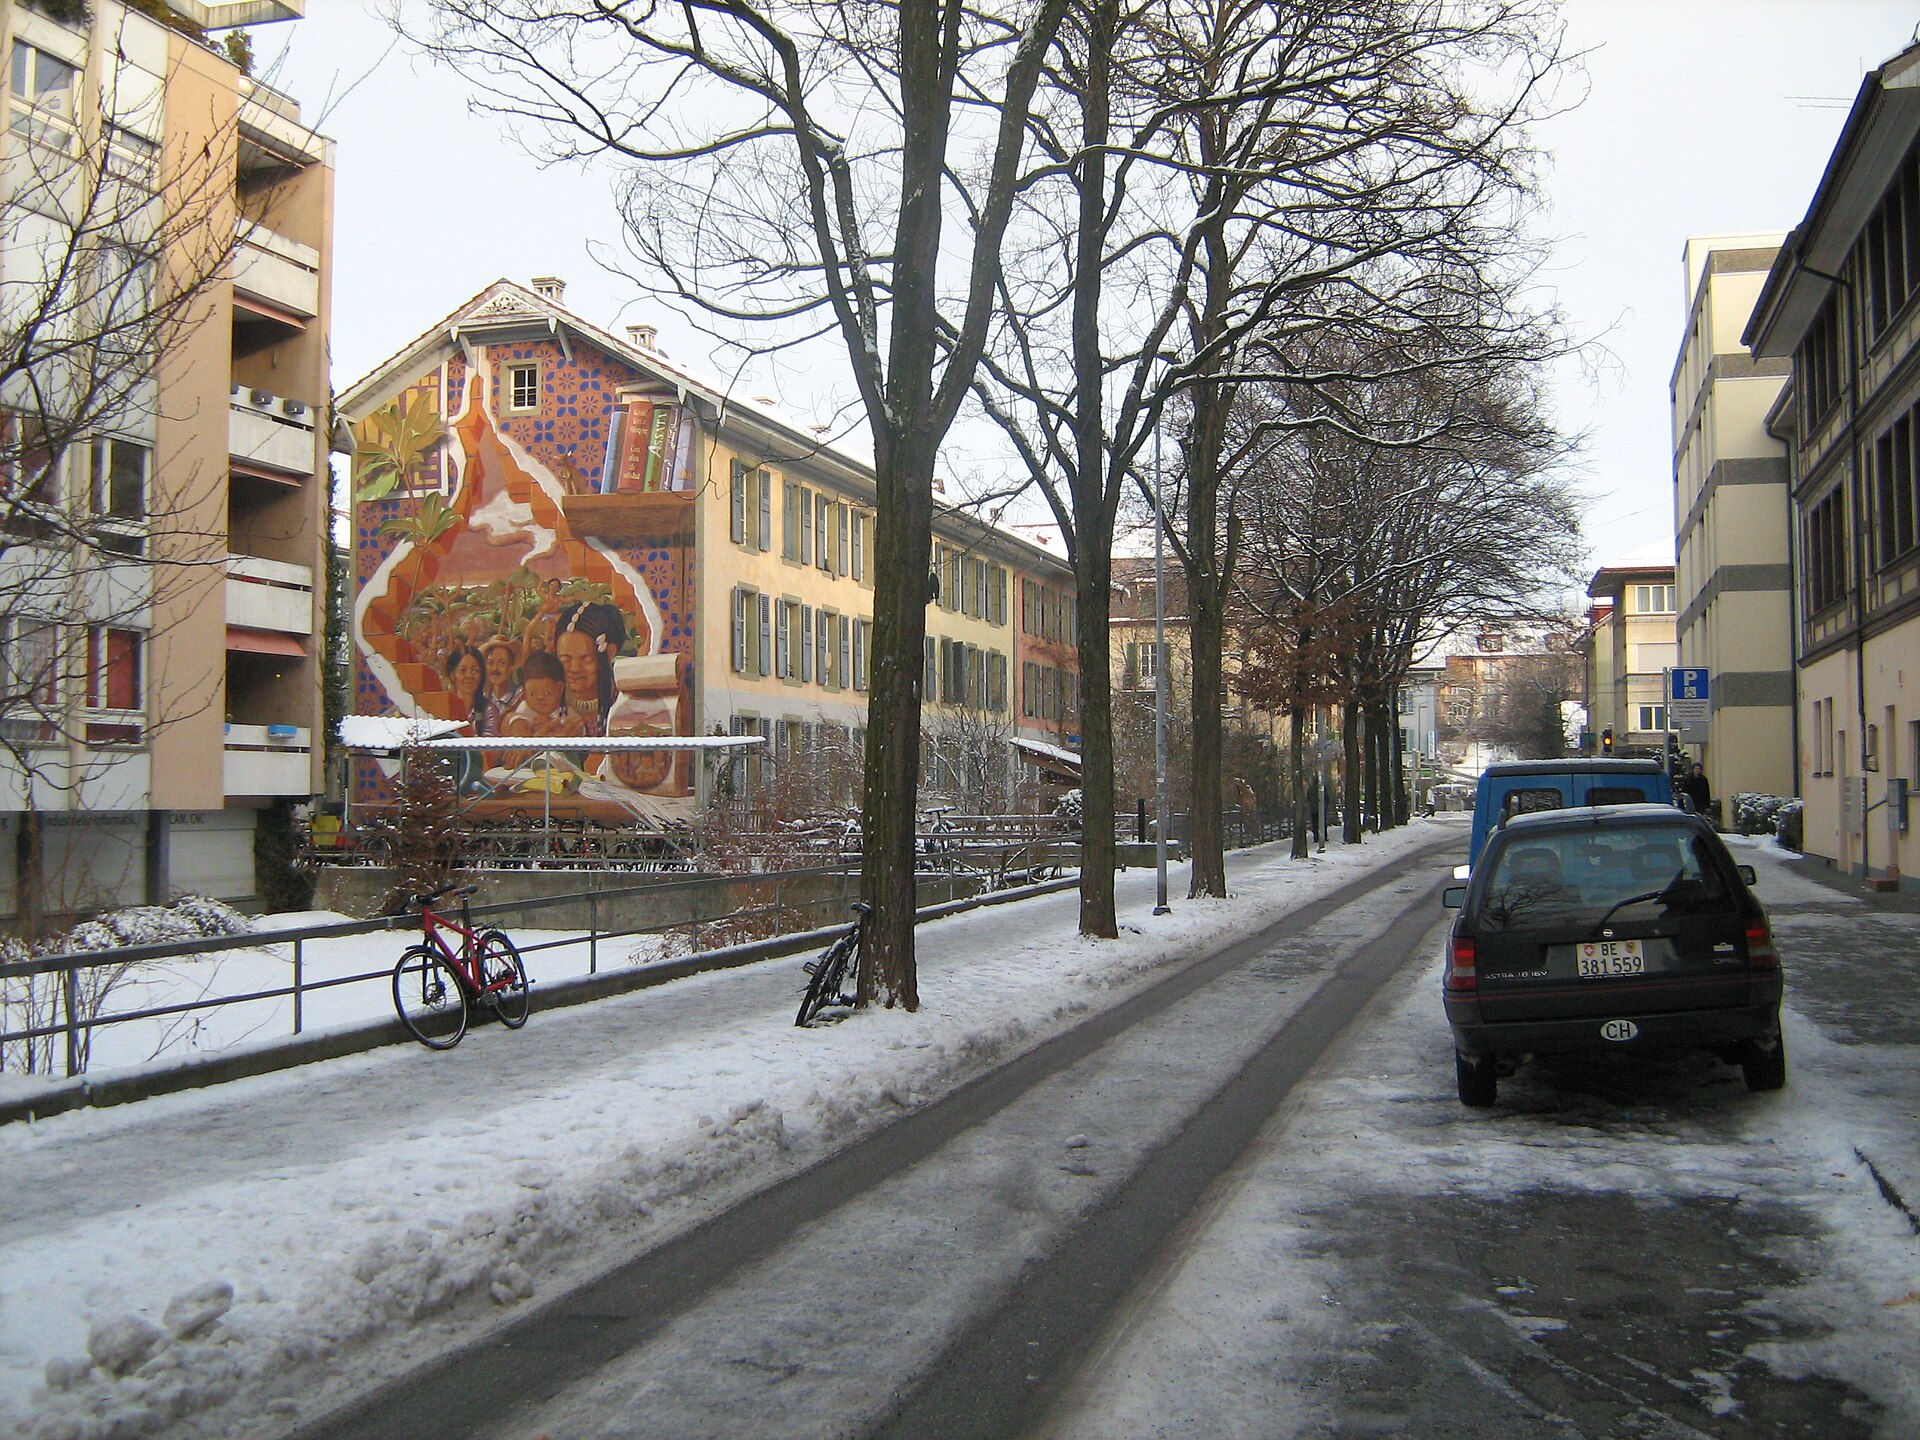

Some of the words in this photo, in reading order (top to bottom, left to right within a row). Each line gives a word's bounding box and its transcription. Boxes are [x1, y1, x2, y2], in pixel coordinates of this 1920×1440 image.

[1683, 670, 1698, 686] P
[1601, 942, 1618, 956] BE
[1485, 971, 1515, 980] ASTRA
[1606, 1022, 1630, 1039] CH
